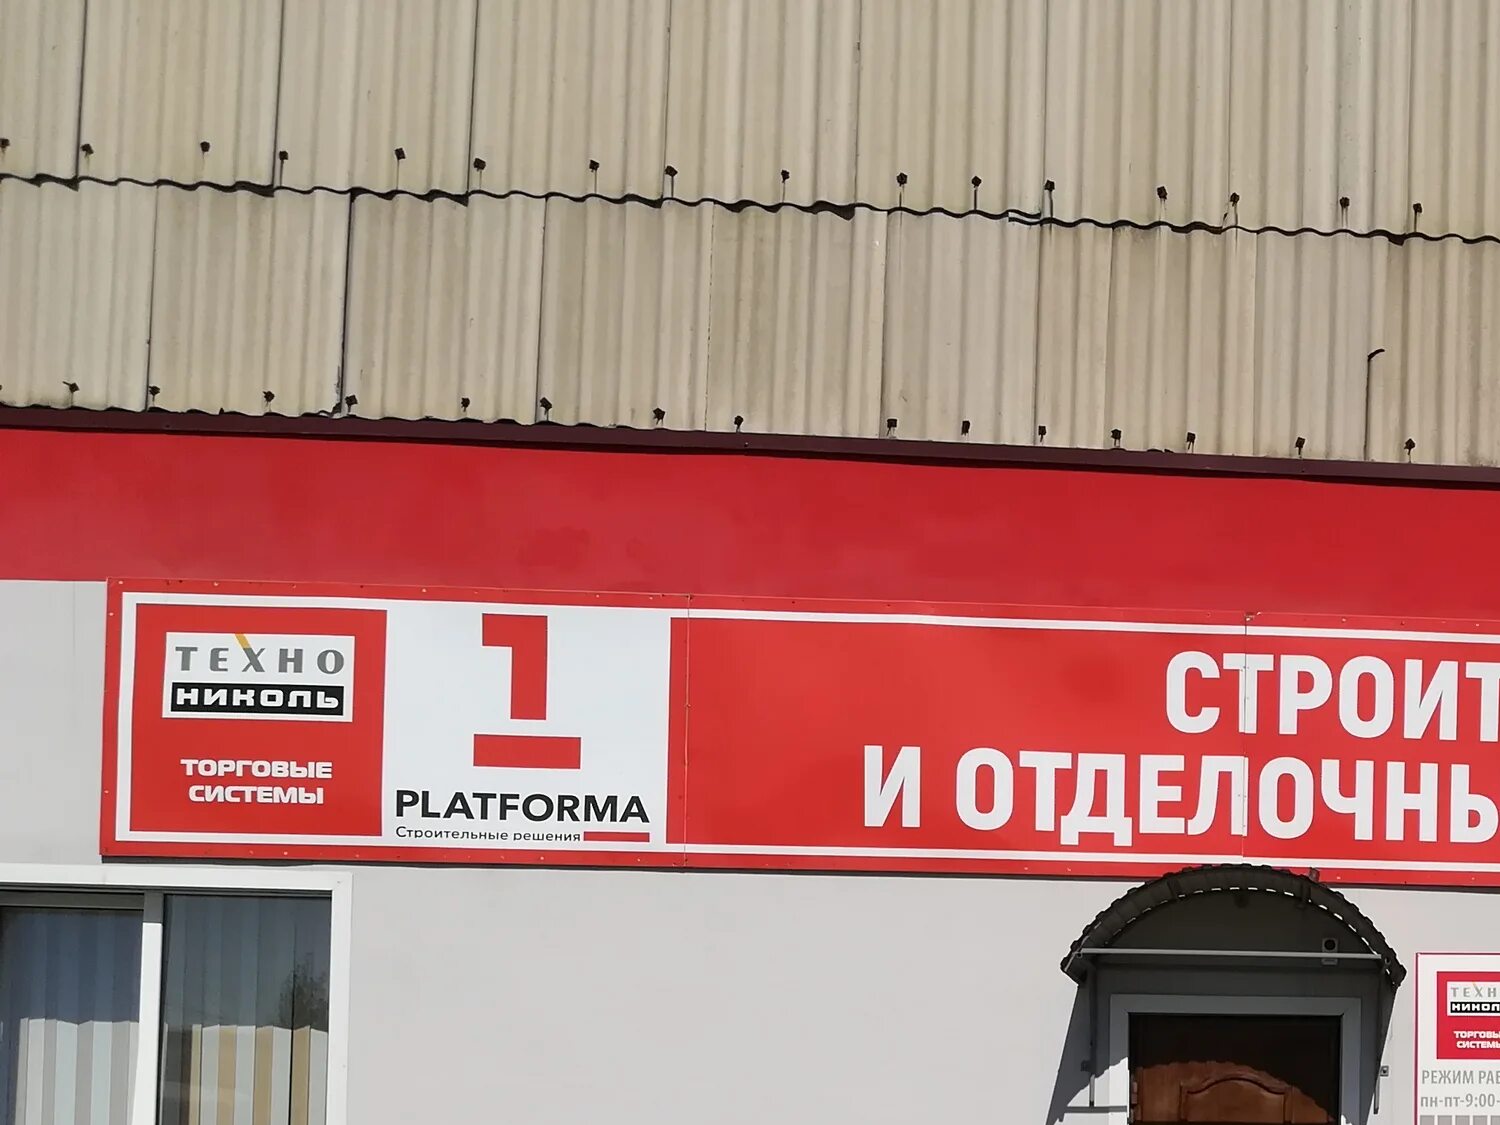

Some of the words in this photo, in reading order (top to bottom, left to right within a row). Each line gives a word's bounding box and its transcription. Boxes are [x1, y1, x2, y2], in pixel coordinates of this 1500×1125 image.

[175, 641, 345, 675] ТЕХНО
[176, 687, 340, 710] НИКОЛЬ
[180, 759, 333, 779] ТОРГОВЫЕ
[188, 785, 324, 805] СИСТЕМЫ
[864, 745, 921, 828] И
[395, 789, 650, 824] PLATFORMA
[395, 826, 510, 842] Строительные
[512, 832, 581, 843] решения
[1421, 1070, 1474, 1085] РЕЖИМ
